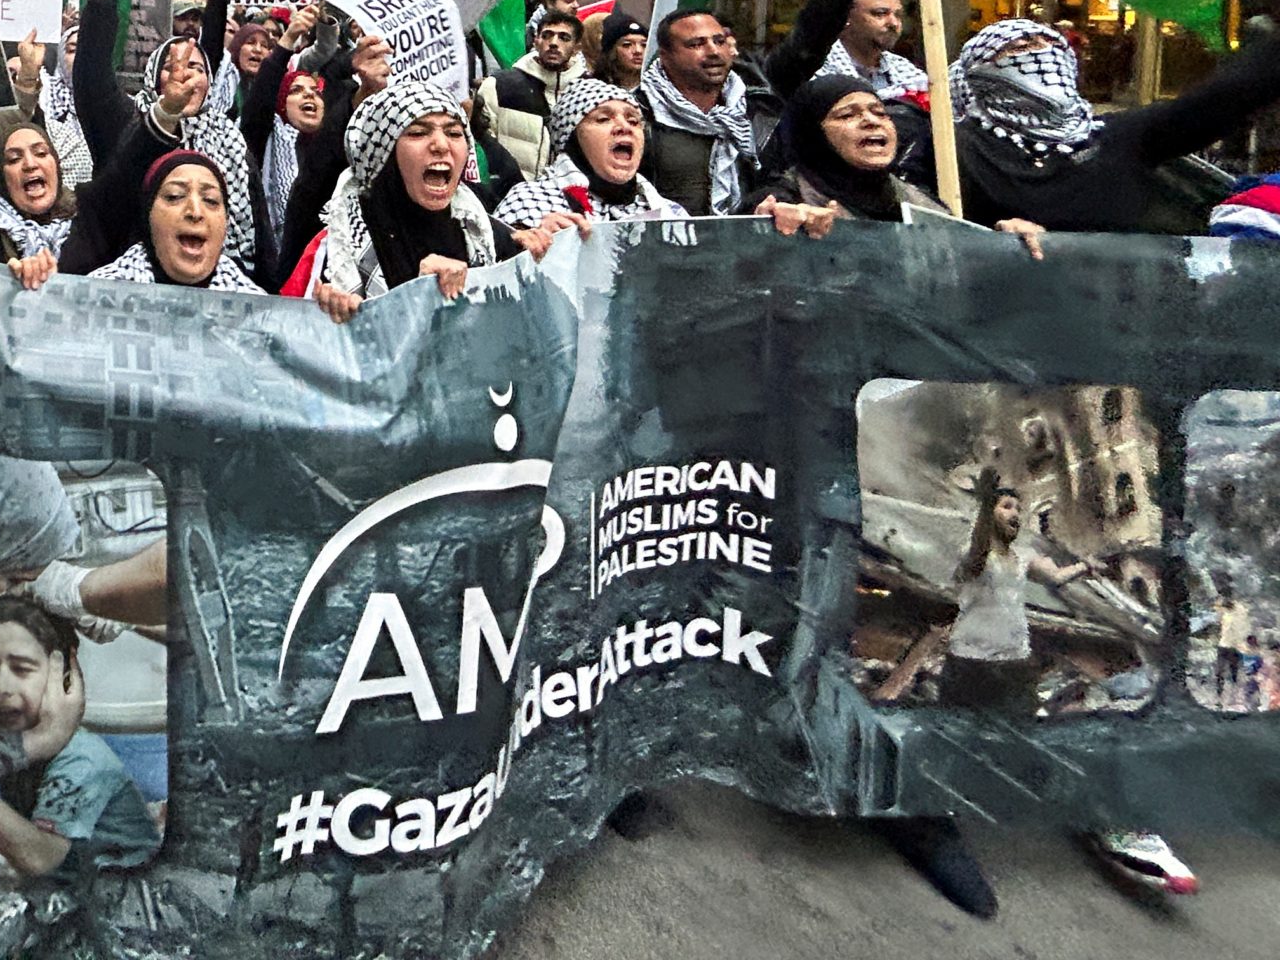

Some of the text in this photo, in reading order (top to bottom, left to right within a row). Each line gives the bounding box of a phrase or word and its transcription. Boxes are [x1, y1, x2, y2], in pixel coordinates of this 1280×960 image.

[377, 17, 397, 34] YOU
[397, 7, 423, 24] CAN'T
[386, 9, 450, 58] YOU'RE
[390, 33, 455, 77] COMMITTING
[395, 50, 458, 86] NOCIDE
[599, 460, 776, 519] AMERICAN
[598, 498, 773, 556] MUSLIMS for
[597, 531, 772, 594] PALESTINE
